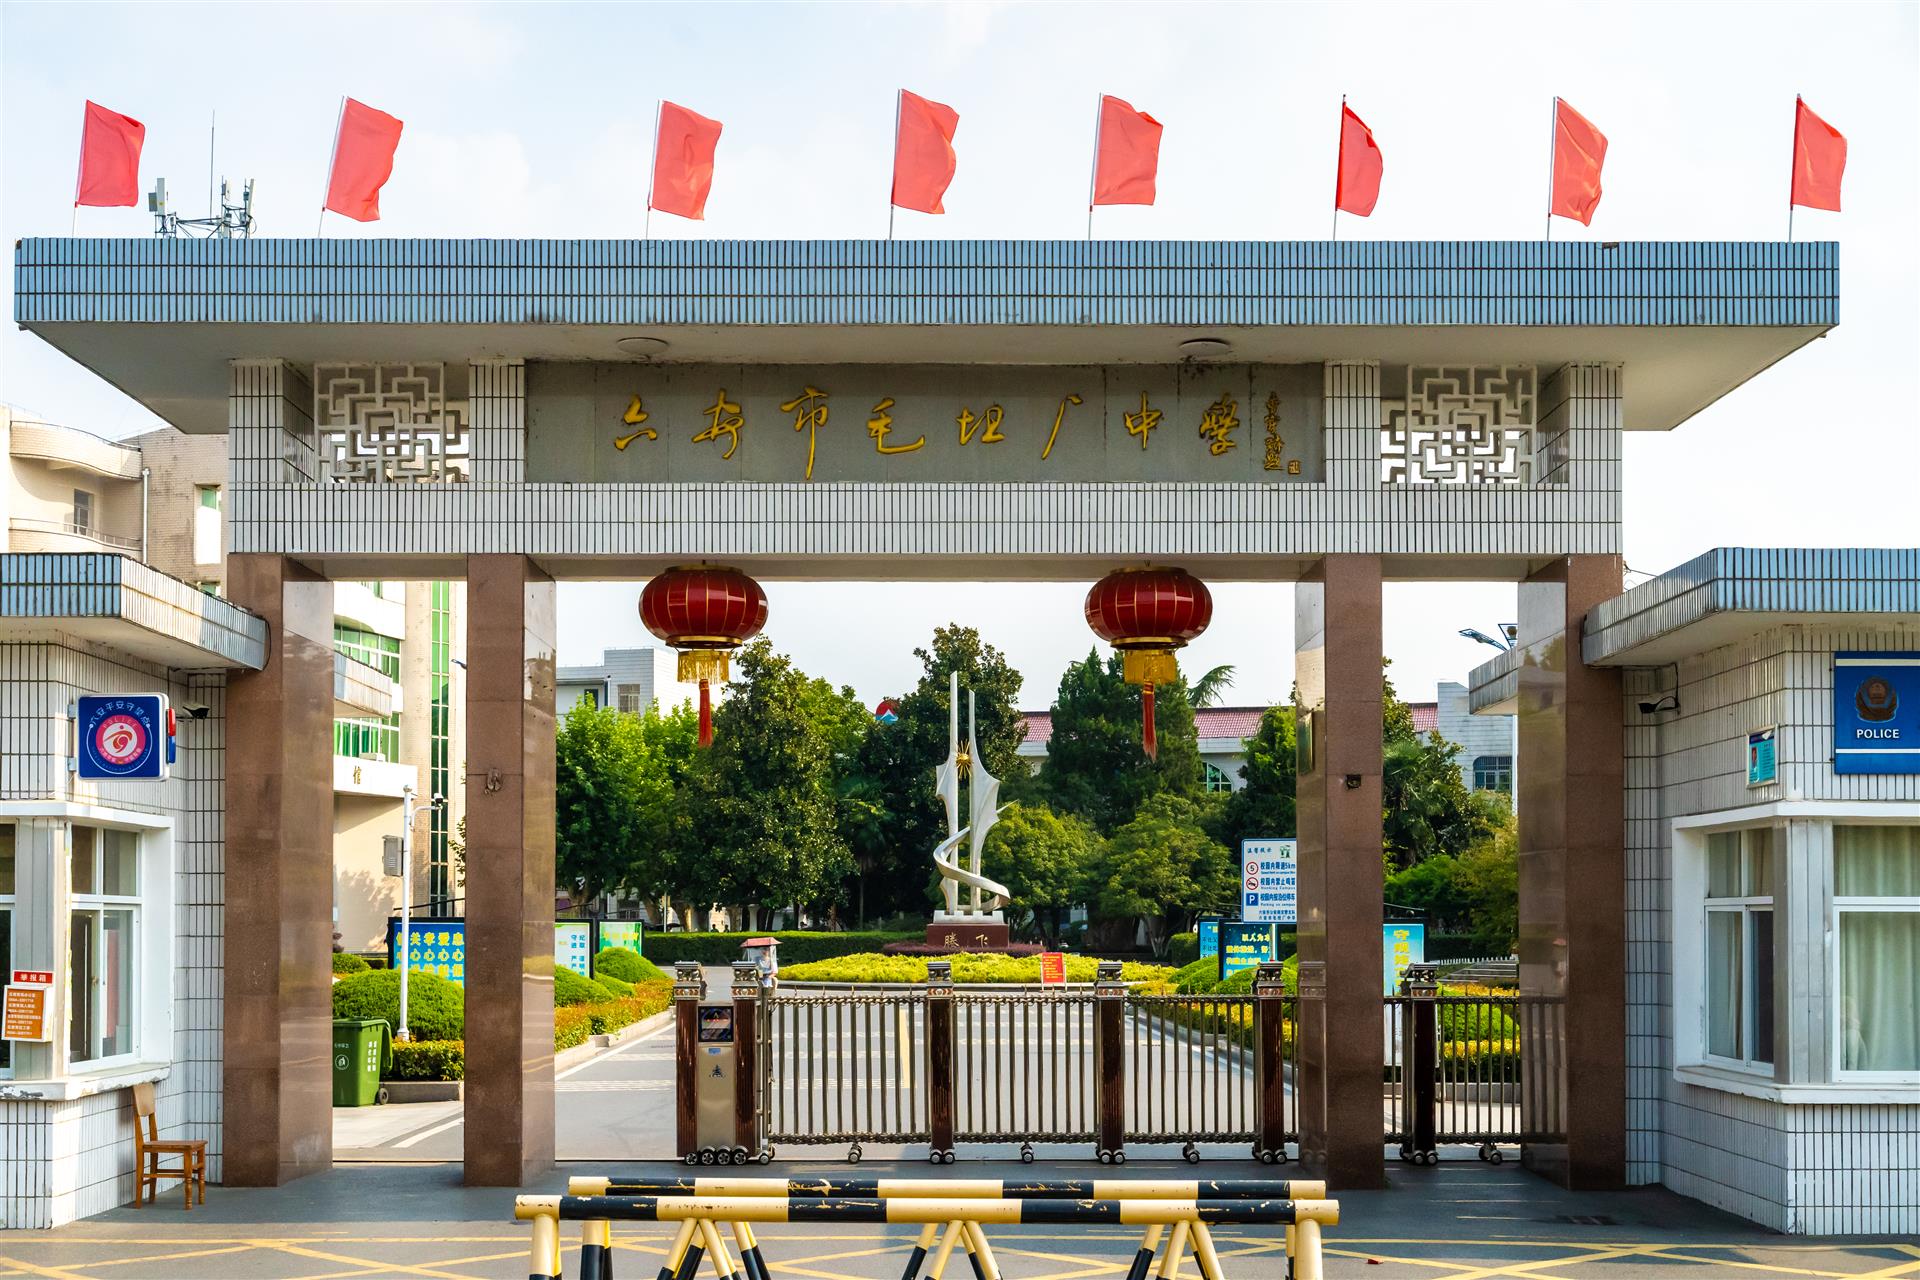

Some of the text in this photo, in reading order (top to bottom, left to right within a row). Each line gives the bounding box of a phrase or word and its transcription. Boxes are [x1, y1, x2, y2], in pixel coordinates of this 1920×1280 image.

[1856, 729, 1899, 738] POLICE
[20, 974, 47, 982] 举报箱
